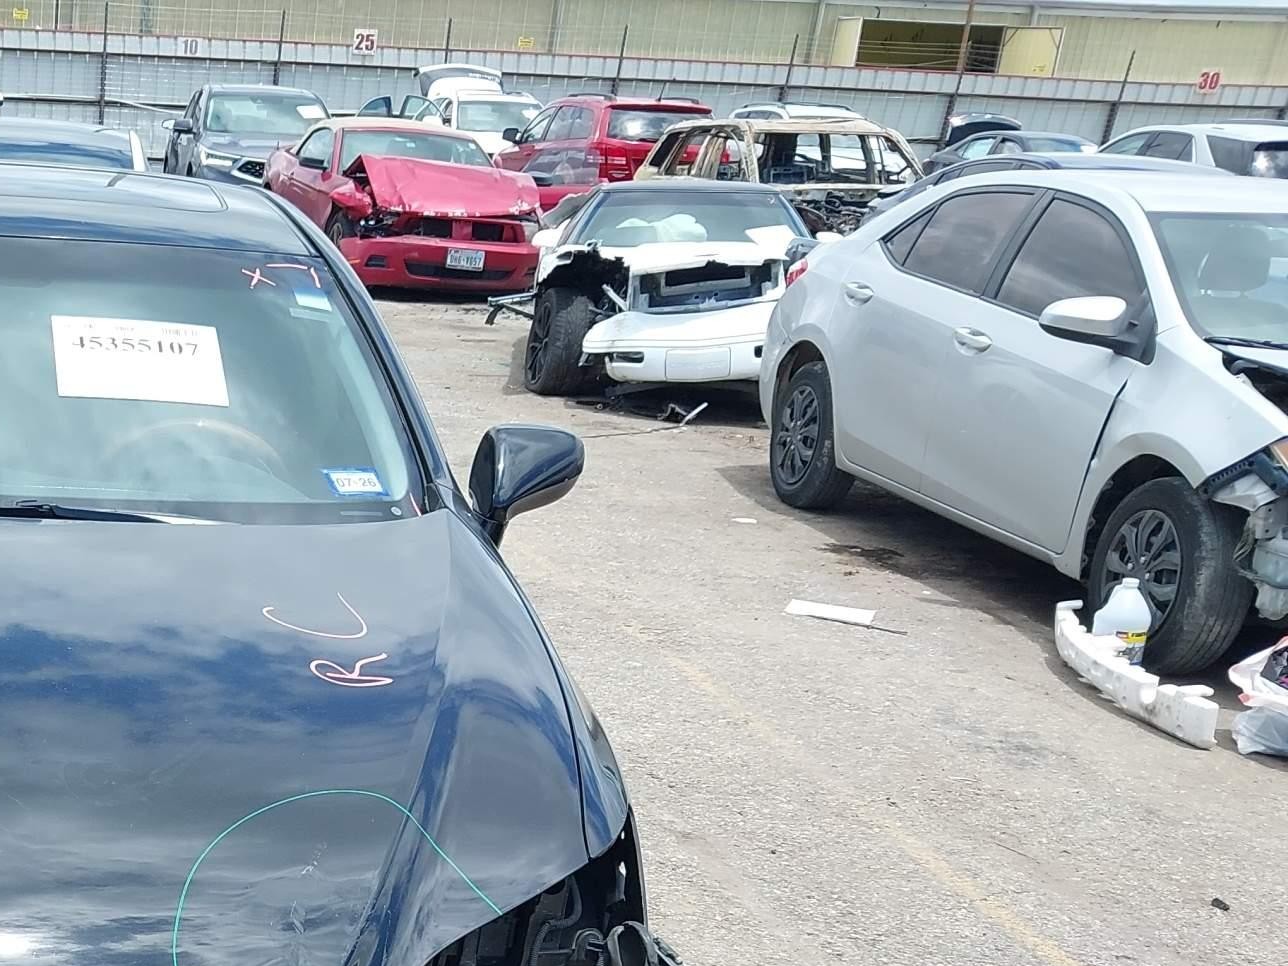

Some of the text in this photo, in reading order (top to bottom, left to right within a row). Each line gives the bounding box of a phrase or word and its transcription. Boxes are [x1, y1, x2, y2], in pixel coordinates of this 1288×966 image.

[182, 38, 199, 55] 10
[355, 33, 375, 52] 25
[1198, 71, 1221, 90] 30
[71, 335, 200, 357] 45355107
